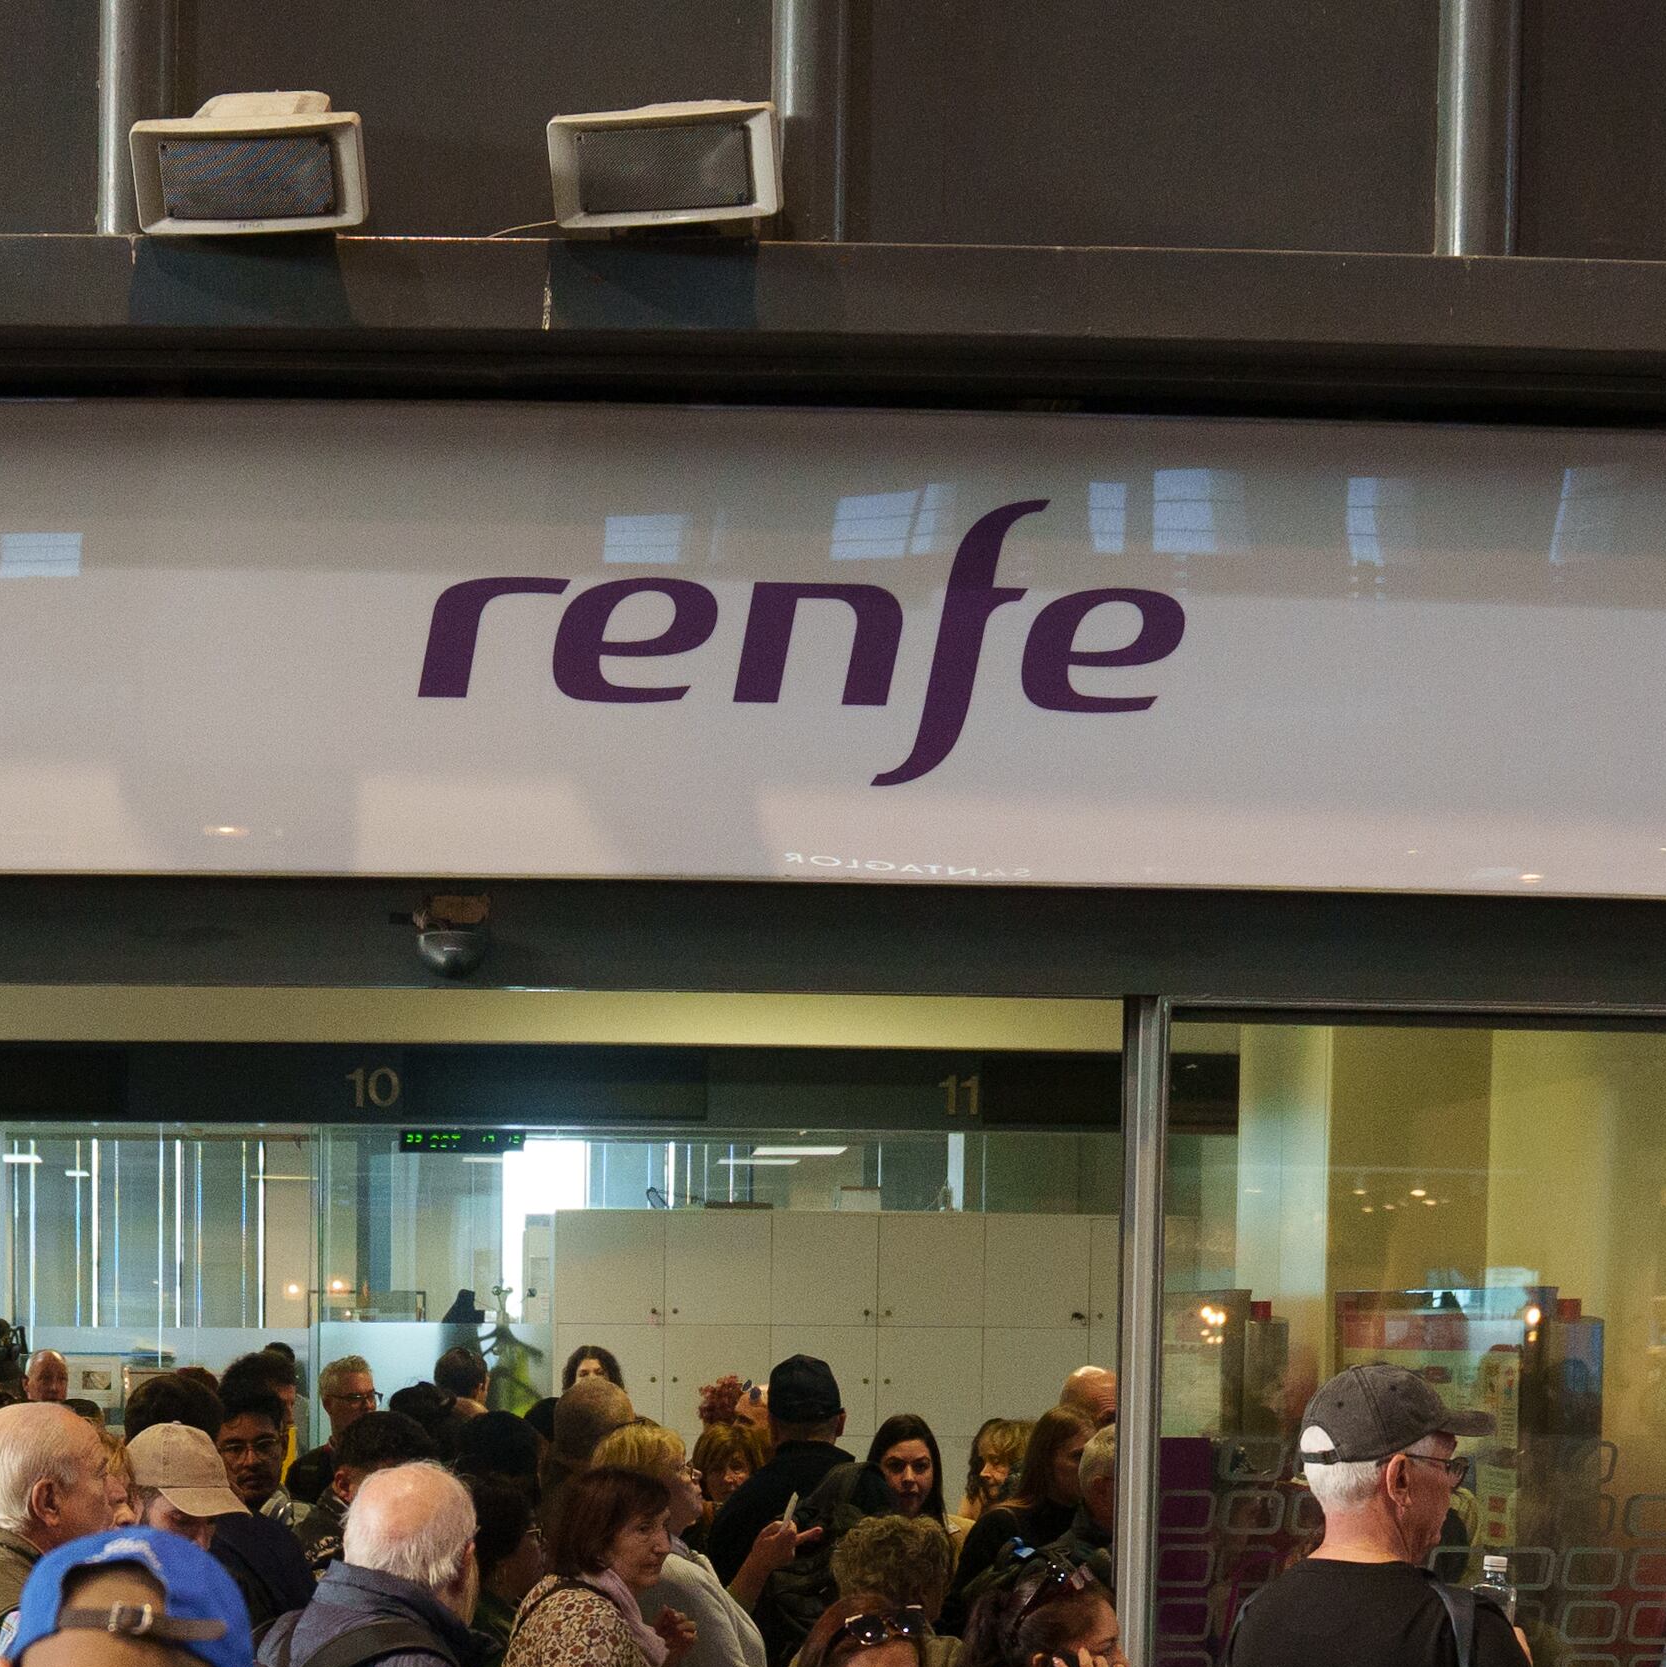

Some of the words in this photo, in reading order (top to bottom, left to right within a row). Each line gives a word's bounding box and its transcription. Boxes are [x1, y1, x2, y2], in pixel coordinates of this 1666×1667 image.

[417, 499, 1185, 787] renfe
[346, 1067, 400, 1108] 10
[939, 1074, 981, 1117] 11
